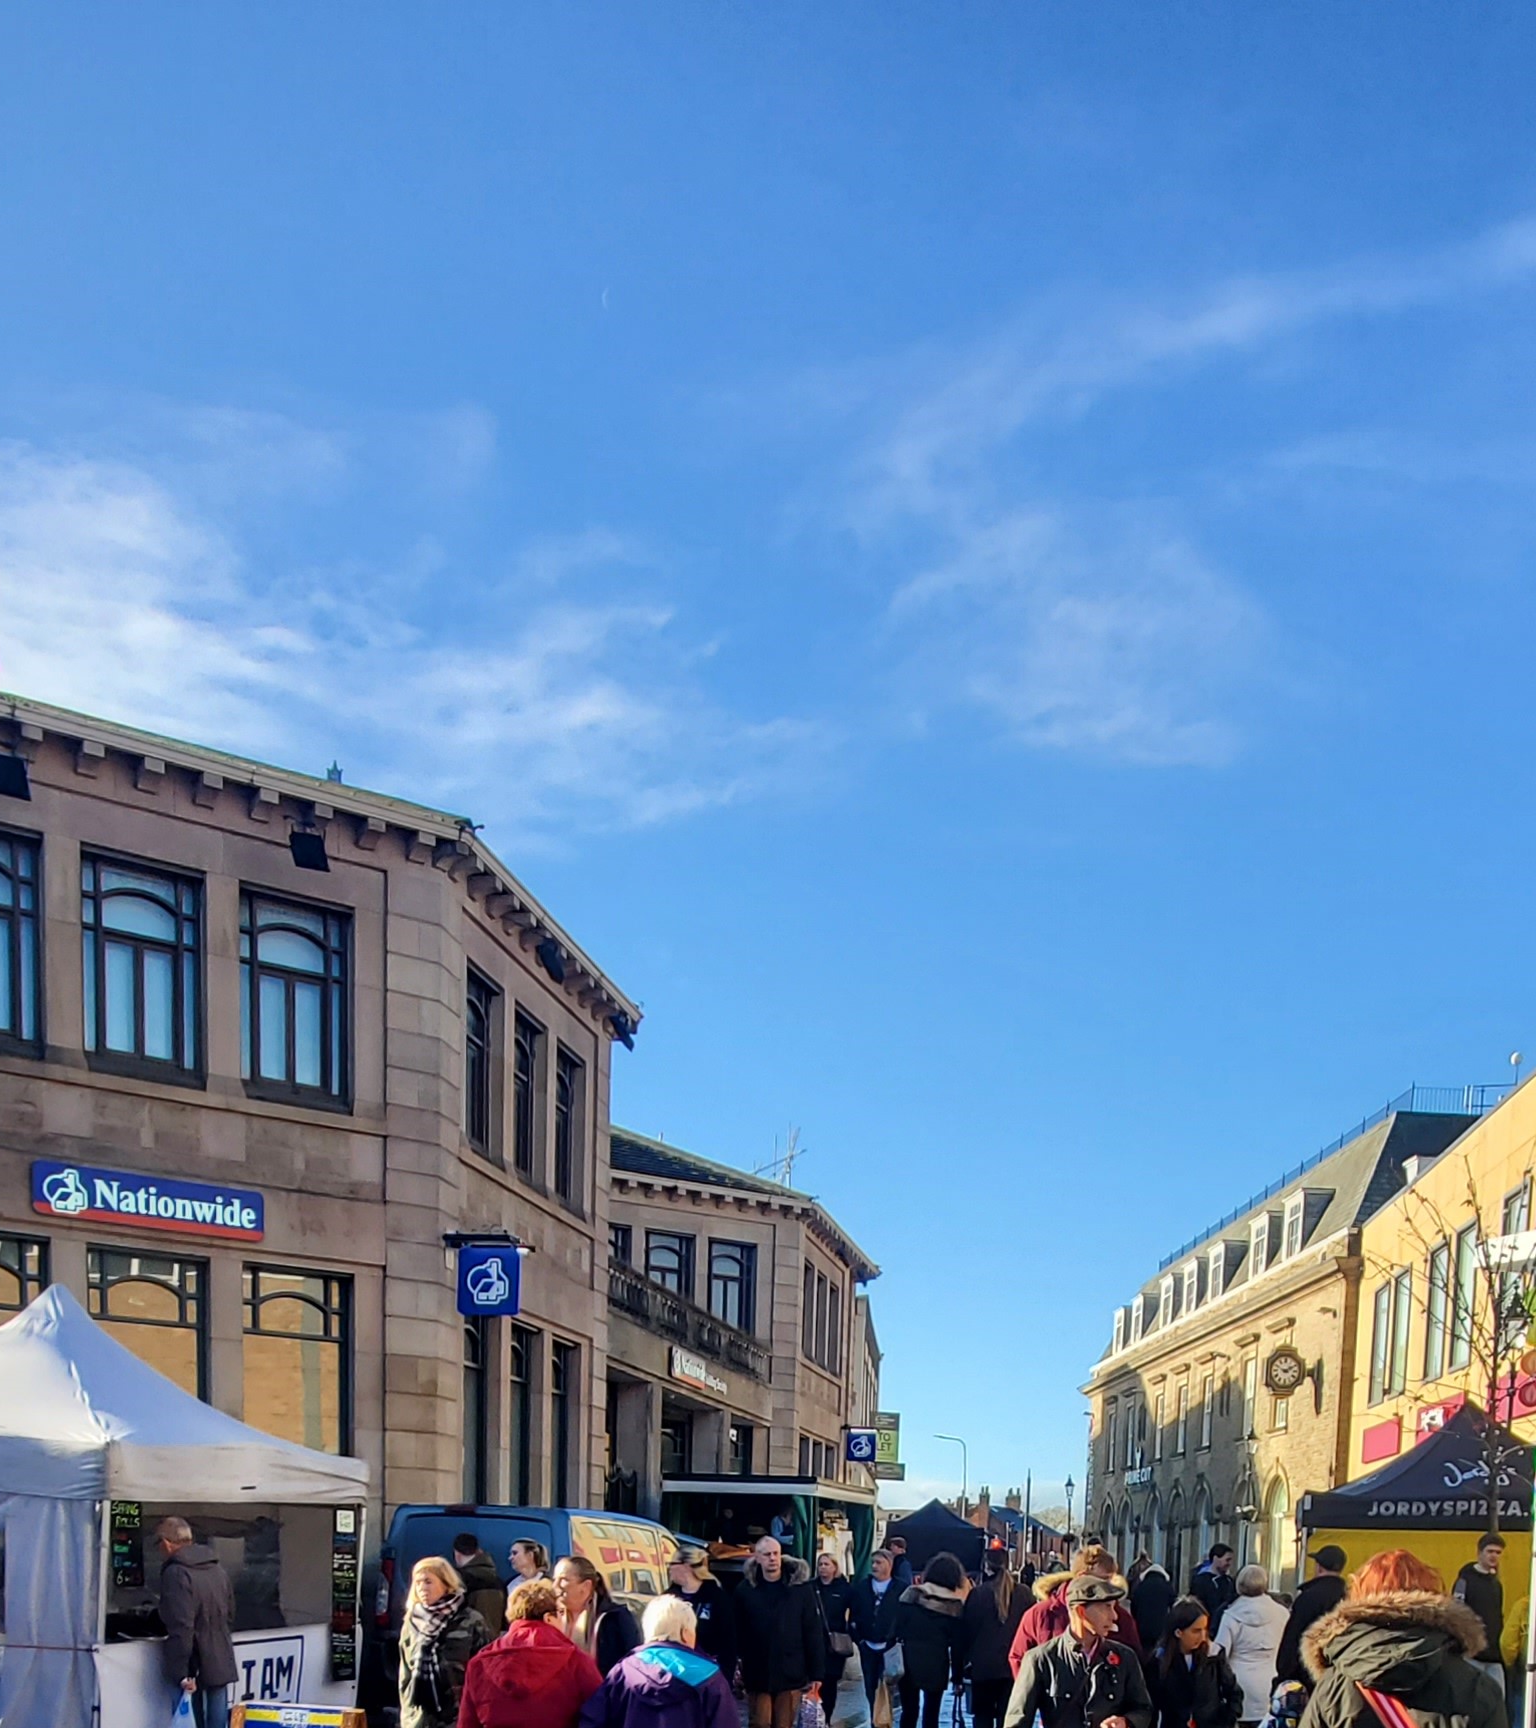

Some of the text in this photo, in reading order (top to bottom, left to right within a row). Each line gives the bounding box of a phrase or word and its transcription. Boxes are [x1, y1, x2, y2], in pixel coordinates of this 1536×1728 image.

[93, 1177, 257, 1229] Nationwide
[878, 1432, 891, 1442] TO
[241, 1654, 295, 1701] I AM
